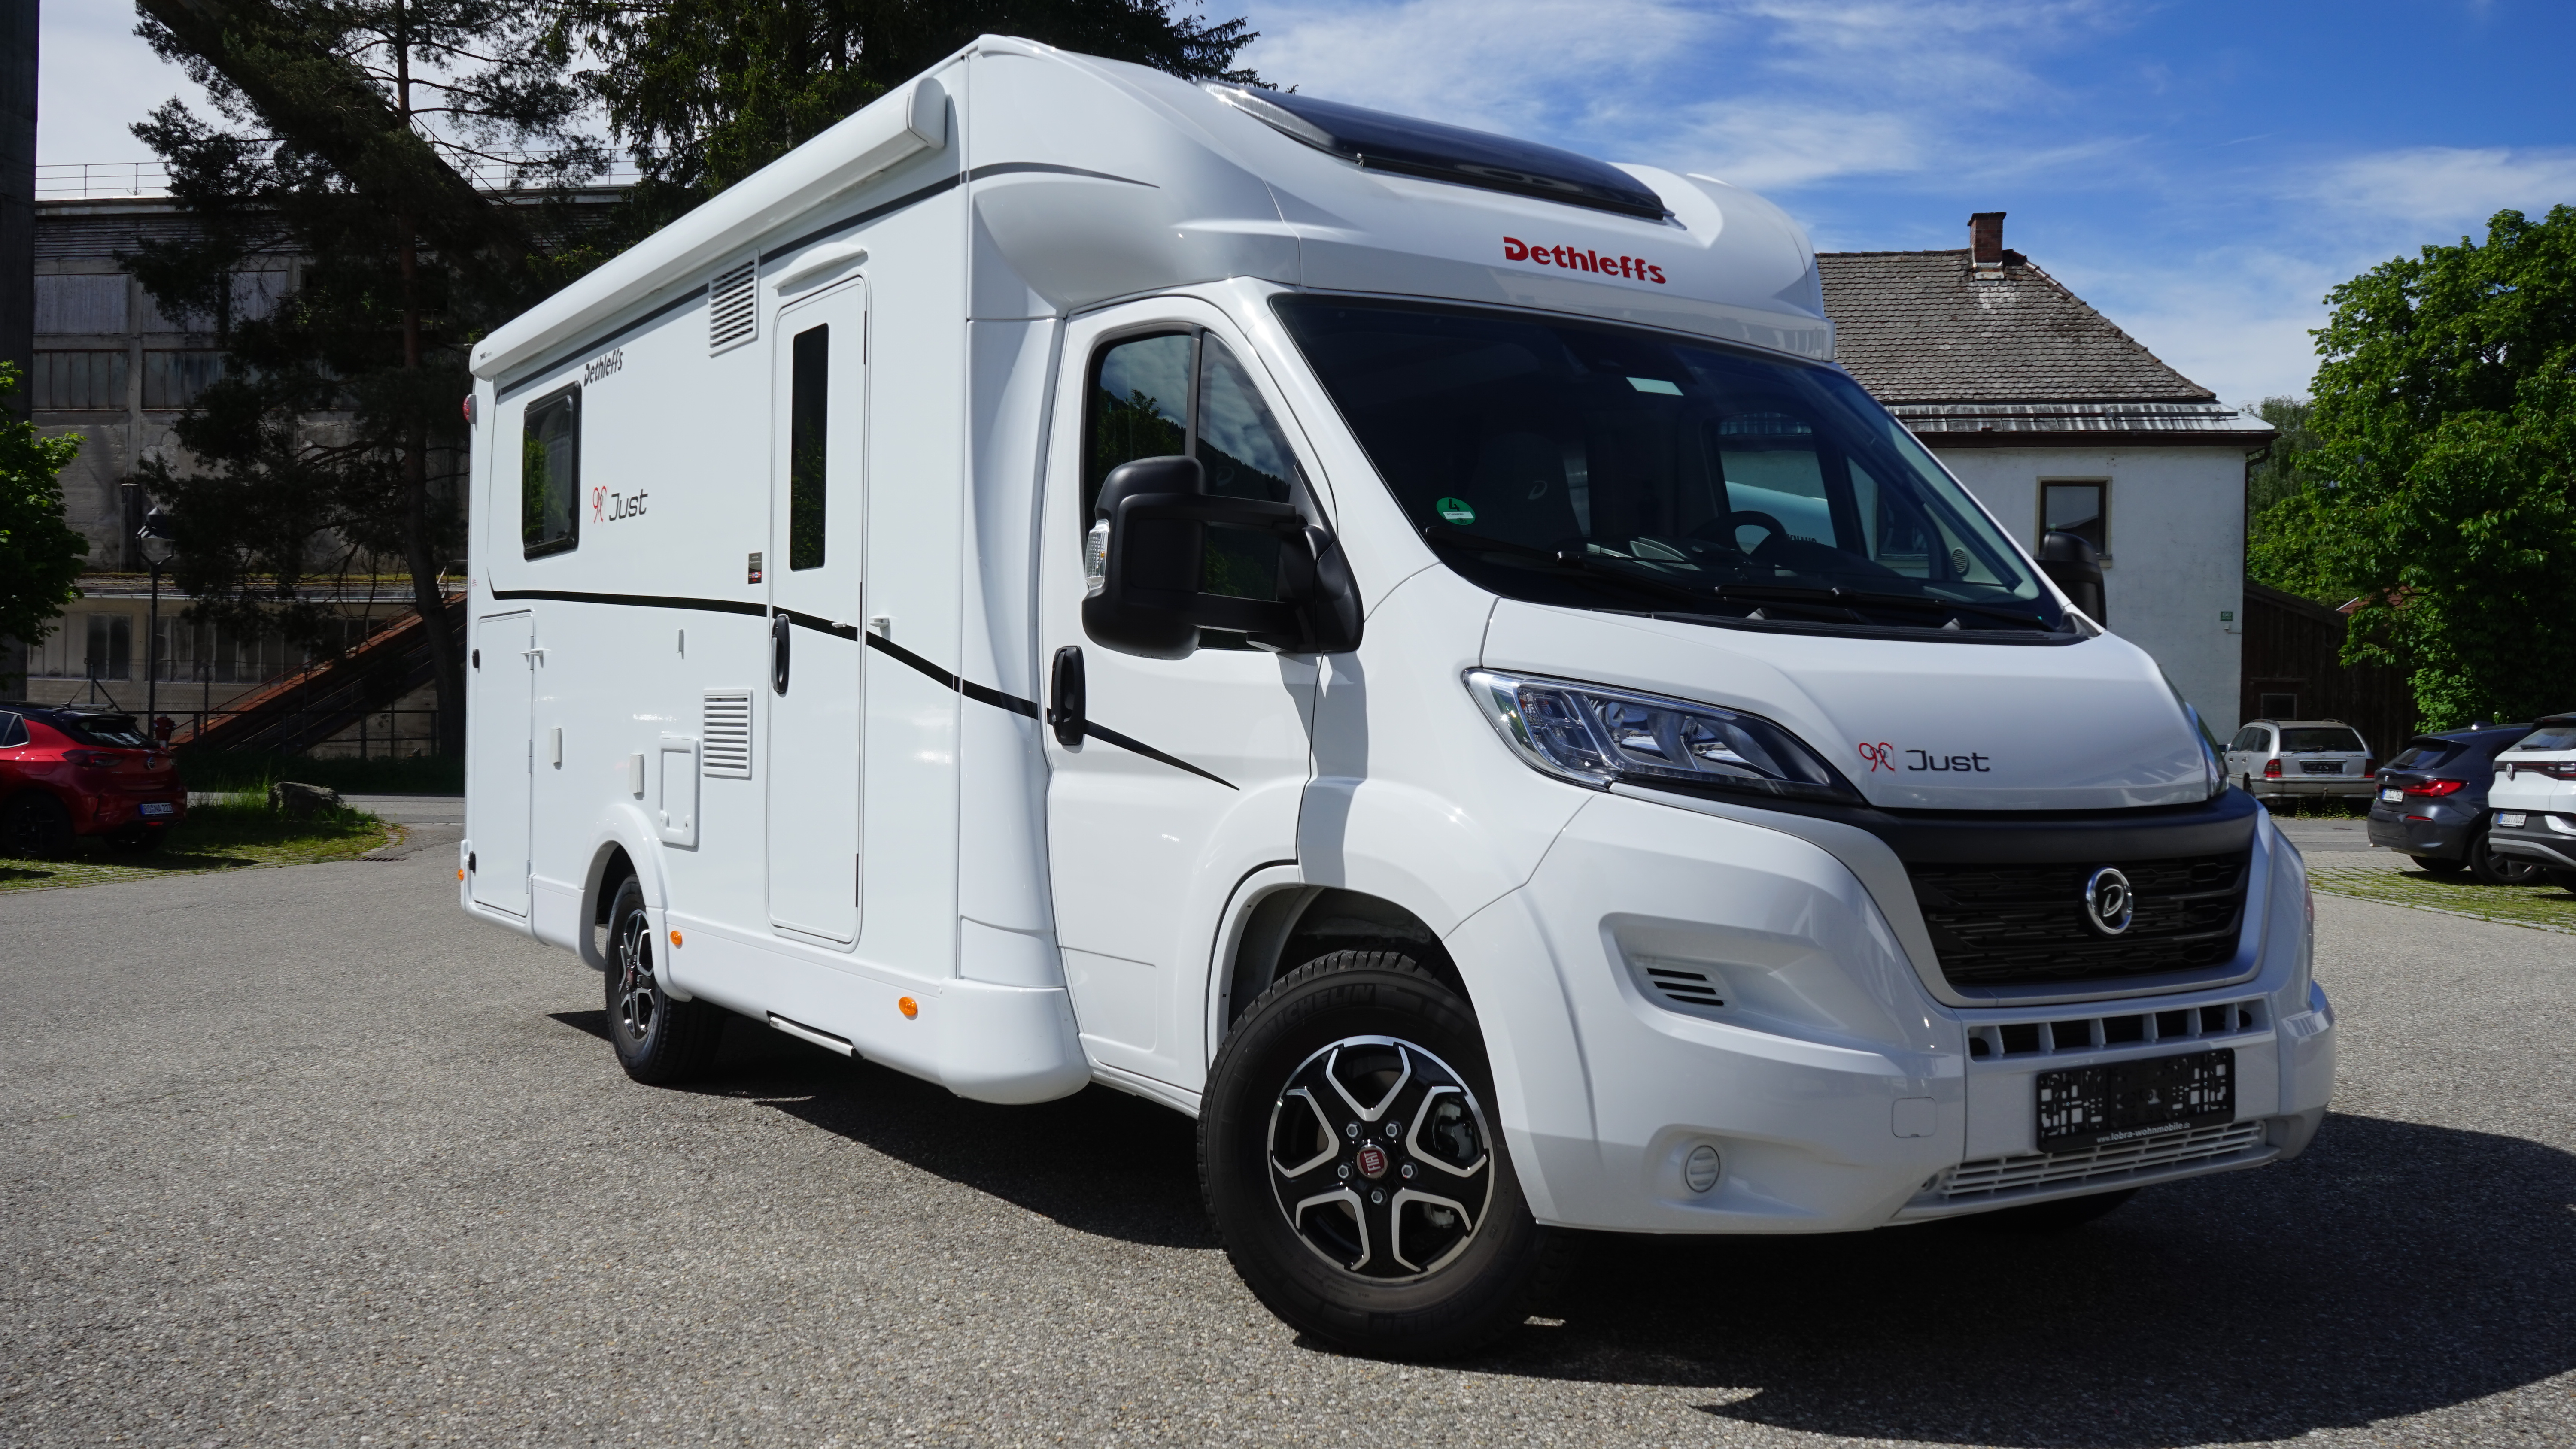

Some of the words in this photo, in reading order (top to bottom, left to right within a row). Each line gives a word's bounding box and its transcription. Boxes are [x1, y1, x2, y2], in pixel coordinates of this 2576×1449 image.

[1503, 236, 1666, 284] Dethleffs
[583, 347, 623, 387] Dethleffs
[609, 488, 648, 521] Just
[1905, 750, 1990, 772] Just
[2097, 1122, 2190, 1143] www.lobra-wohnmobile.de
[1364, 1152, 1381, 1171] FIAT
